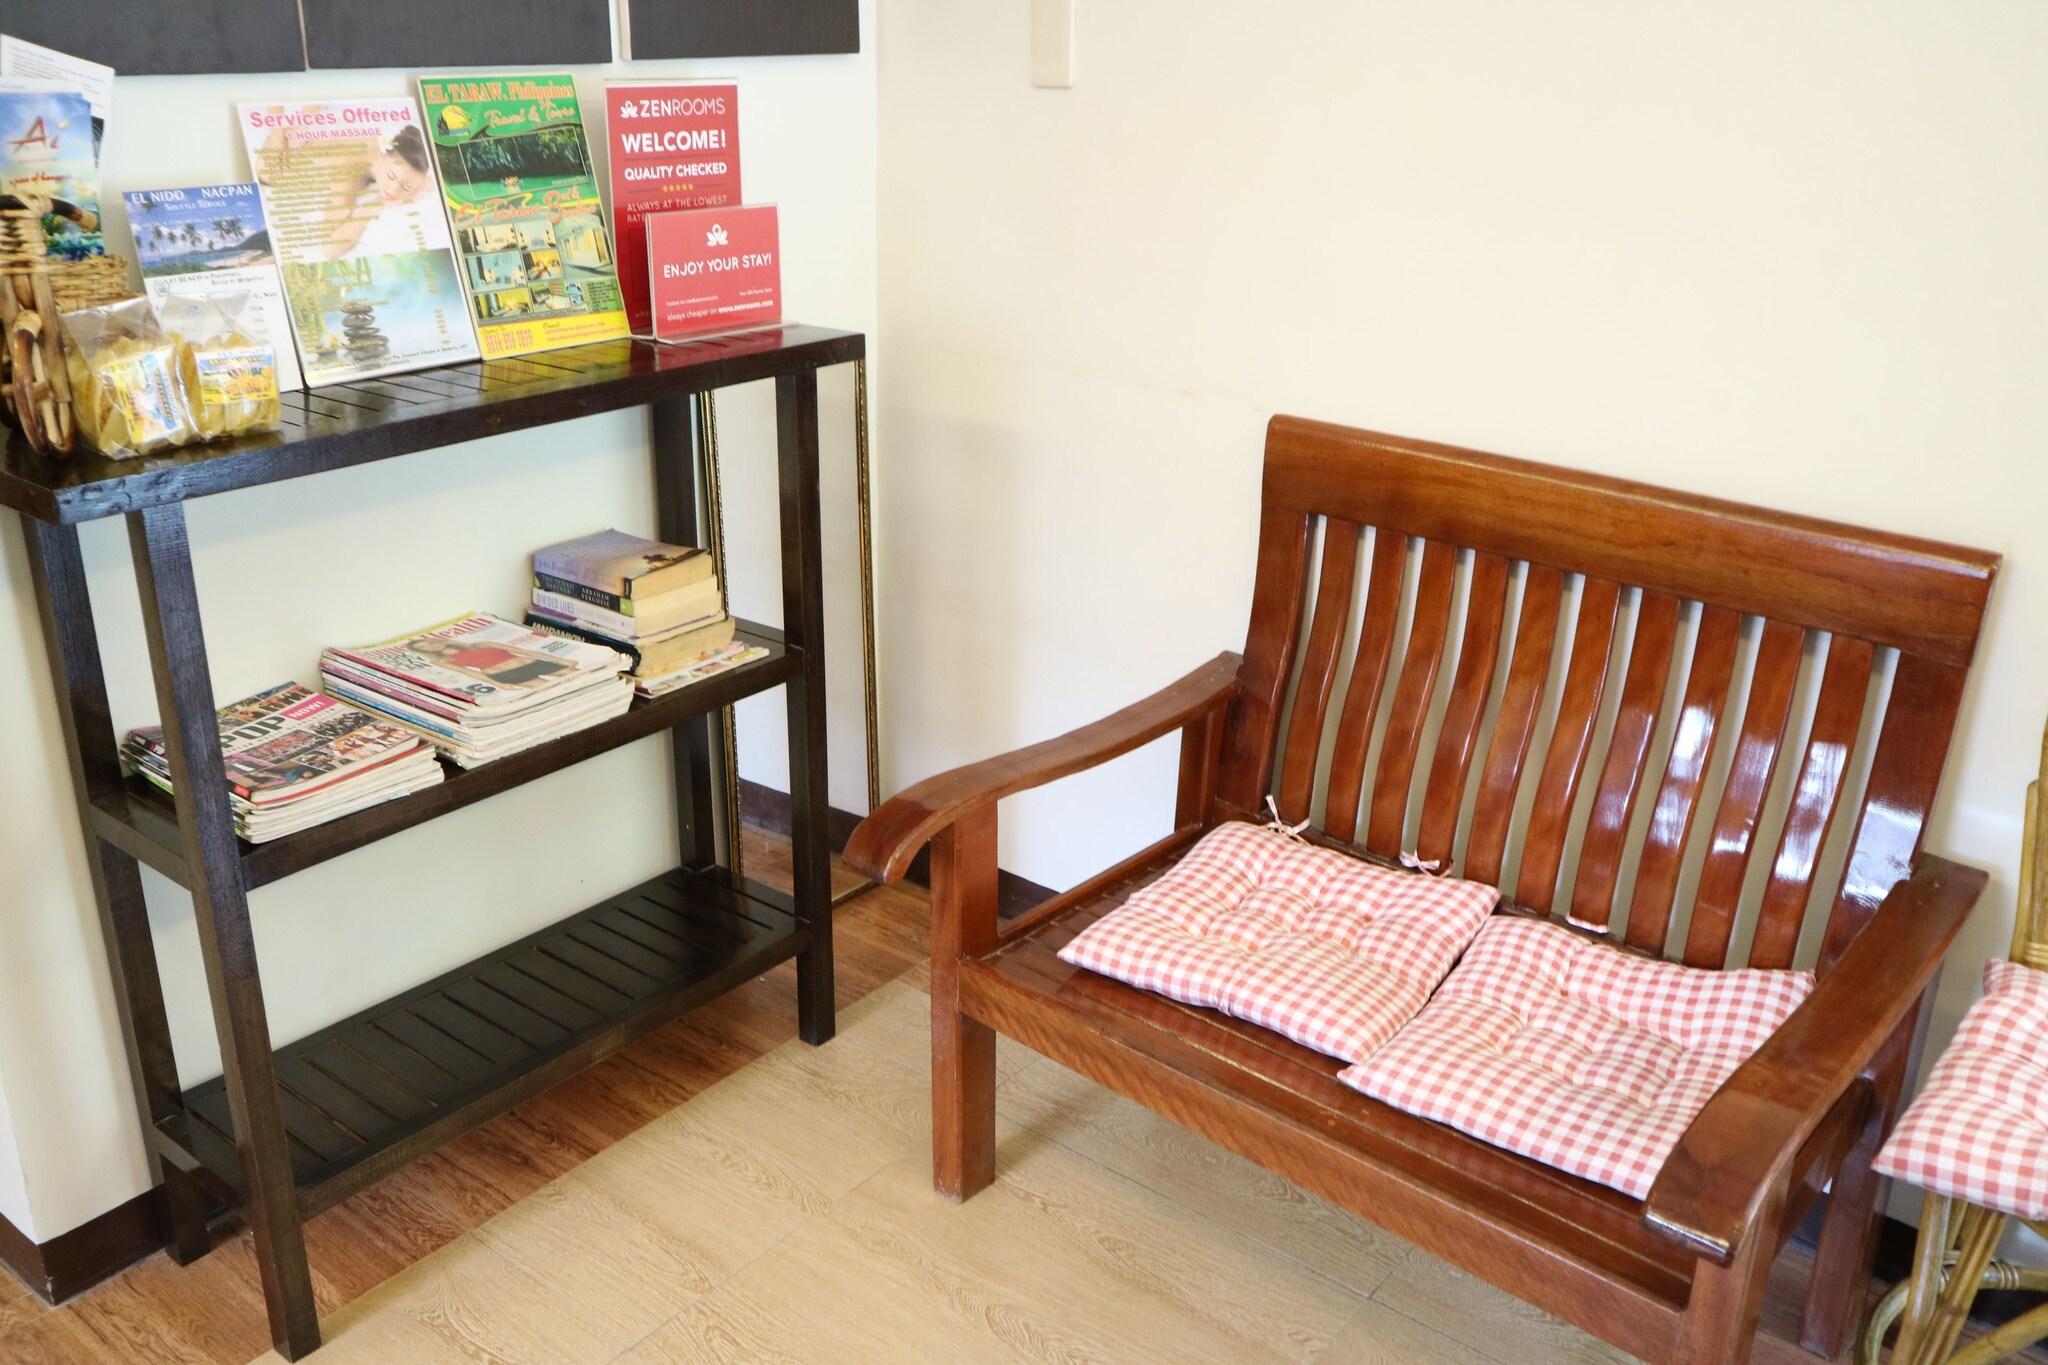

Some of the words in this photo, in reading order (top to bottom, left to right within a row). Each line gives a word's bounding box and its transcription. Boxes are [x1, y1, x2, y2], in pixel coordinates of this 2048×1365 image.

[250, 110, 336, 128] Services
[342, 106, 411, 124] Offered
[640, 97, 725, 118] ZENROOMS
[296, 131, 328, 141] HOUR
[330, 127, 383, 138] MASSAGE
[621, 129, 727, 154] WELCOME!
[624, 165, 673, 181] QUALITY
[676, 162, 728, 177] CHECKED
[131, 193, 149, 204] EL
[151, 190, 185, 202] NIDO
[201, 185, 254, 200] NACPAN
[627, 201, 660, 212] ALWAYS
[662, 199, 673, 209] AT
[675, 197, 691, 207] THE
[694, 194, 728, 207] LOWEST
[663, 261, 704, 279] ENJOY
[707, 257, 739, 272] YOUR
[742, 253, 772, 268] STAY!
[536, 592, 558, 609] DIVIDED
[560, 597, 575, 614] LIVES
[220, 716, 286, 749] POP
